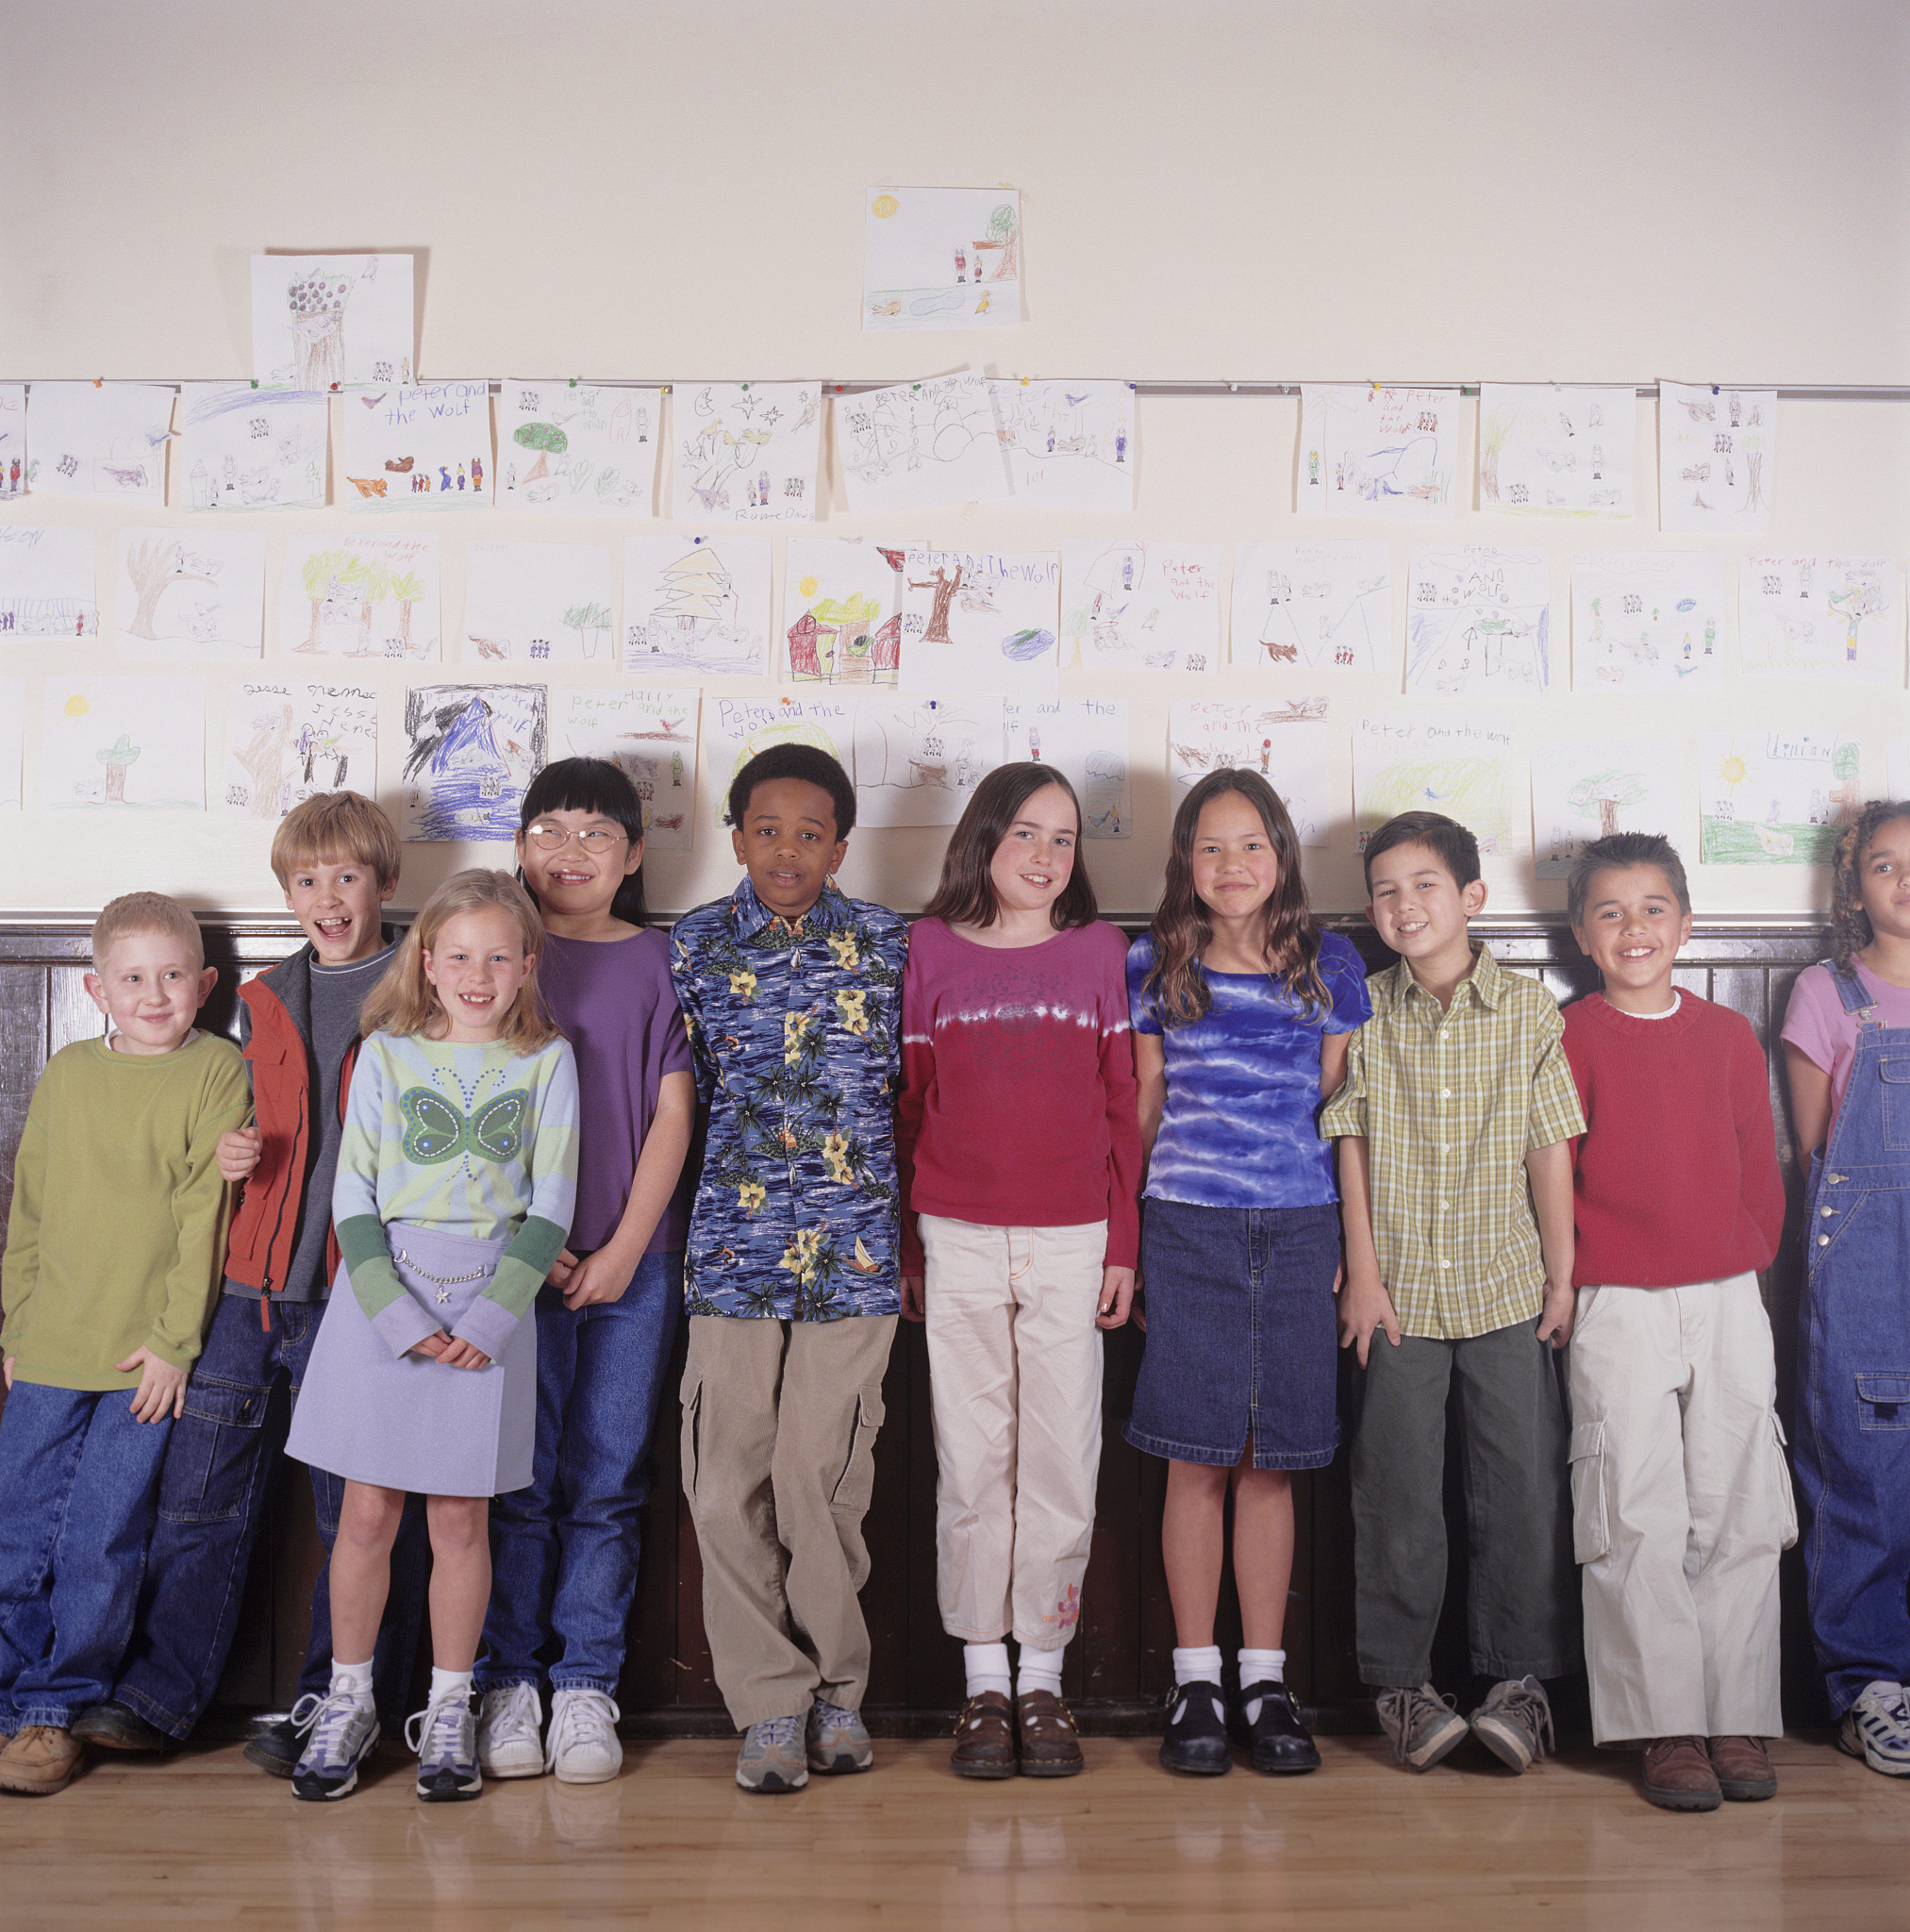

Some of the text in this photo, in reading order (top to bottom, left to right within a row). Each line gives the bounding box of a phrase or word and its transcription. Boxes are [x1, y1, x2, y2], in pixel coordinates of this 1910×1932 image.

[456, 381, 486, 397] and
[385, 408, 416, 425] the
[1827, 557, 1851, 569] the
[638, 702, 663, 715] and
[668, 706, 689, 716] the
[778, 702, 803, 718] and
[808, 701, 845, 717] the
[1037, 700, 1061, 713] and
[1081, 699, 1116, 715] the
[1203, 721, 1228, 732] and
[1426, 726, 1451, 739] and
[1455, 724, 1483, 739] the
